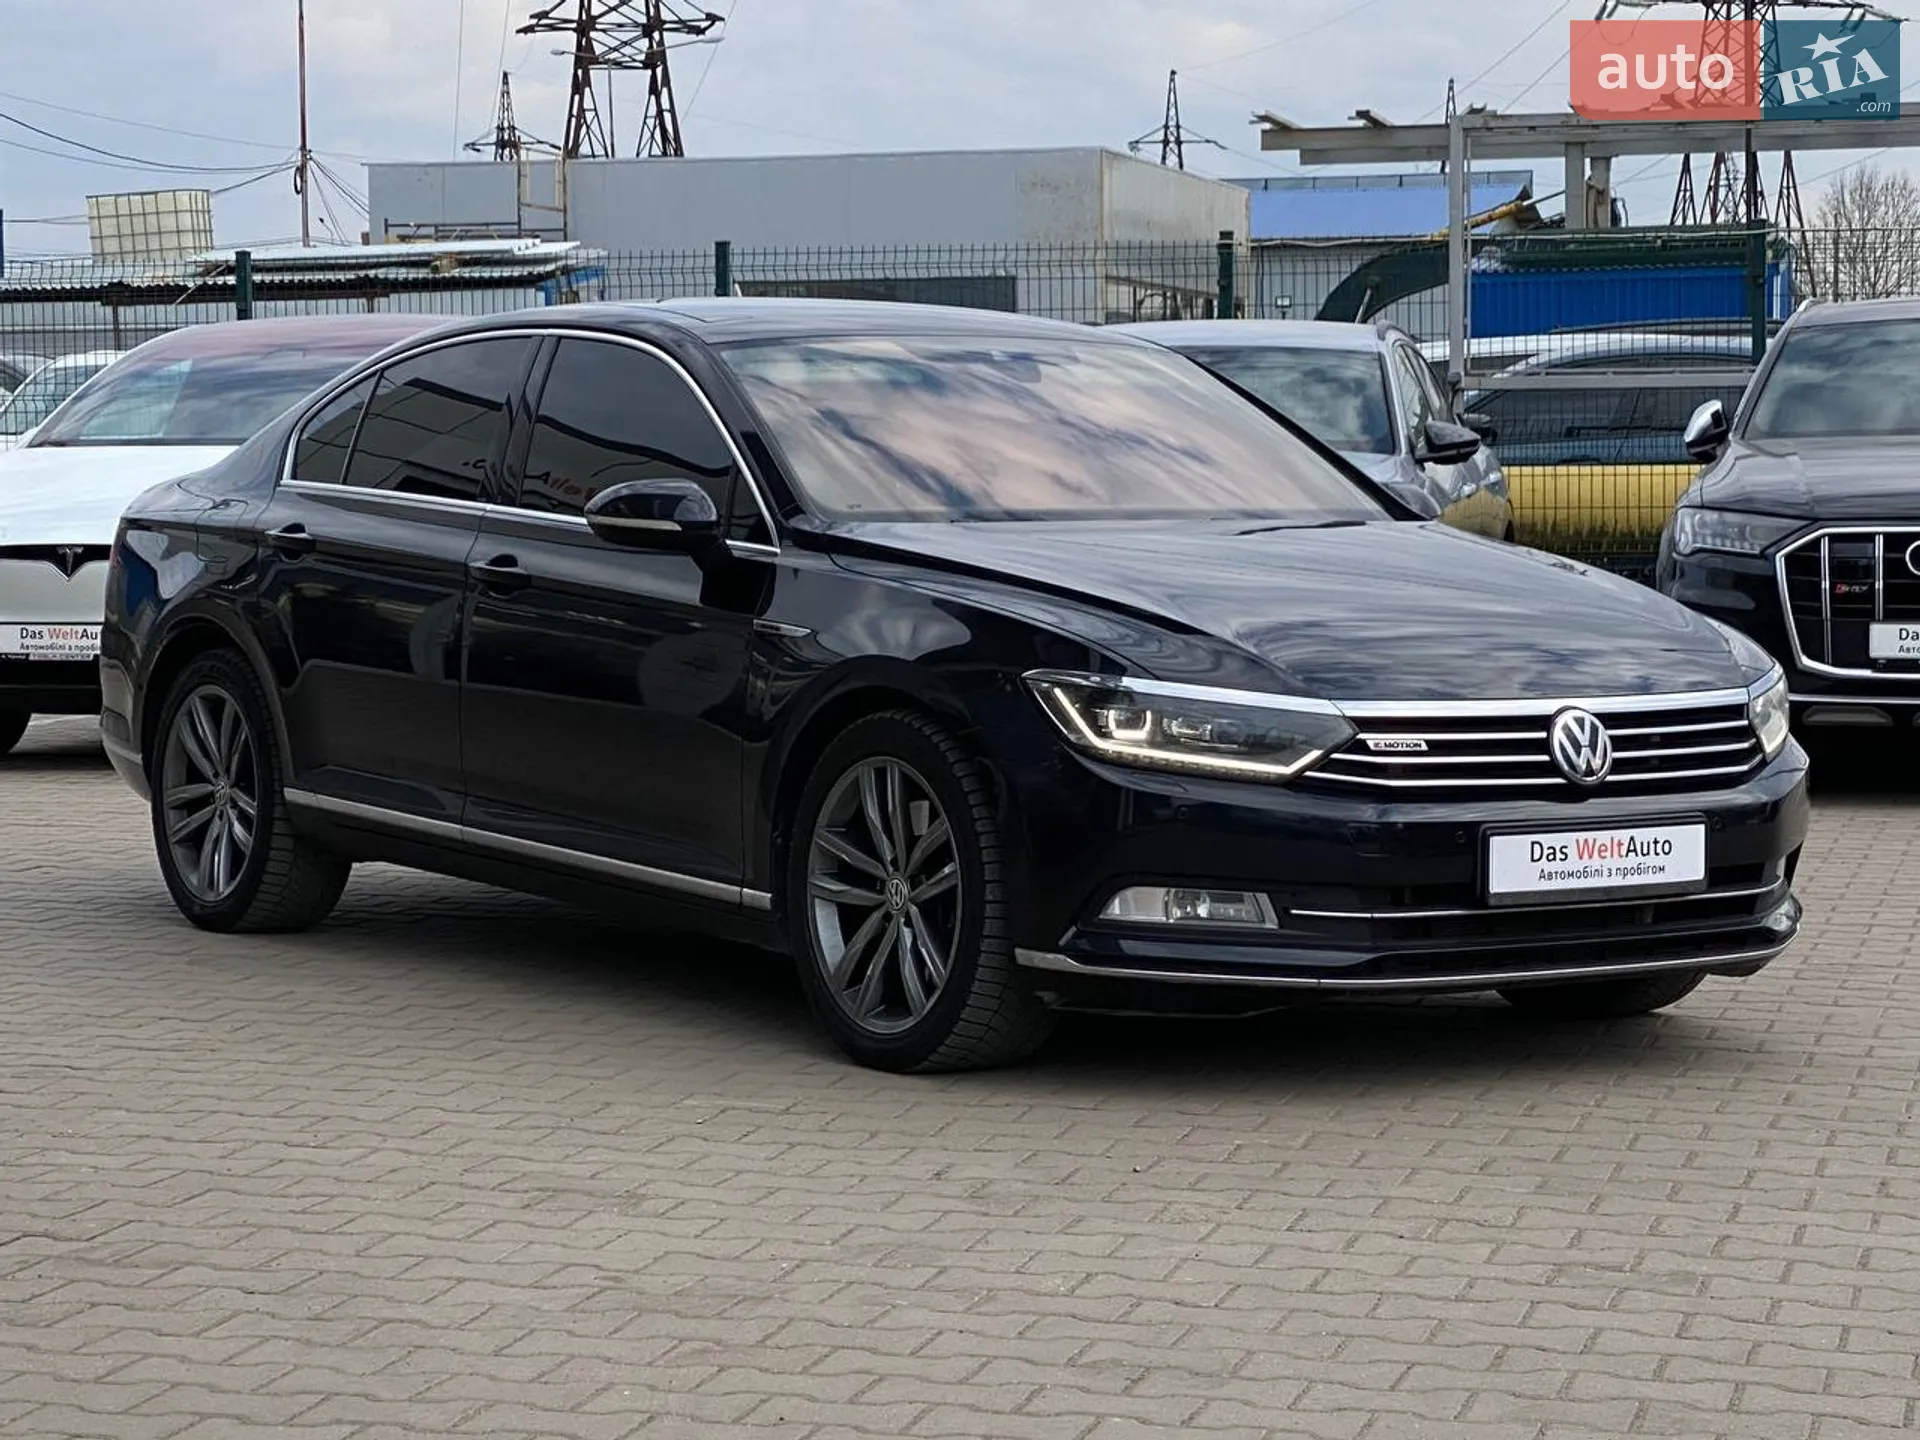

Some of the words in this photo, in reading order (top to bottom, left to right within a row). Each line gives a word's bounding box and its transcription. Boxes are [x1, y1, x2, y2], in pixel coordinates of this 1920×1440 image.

[20, 627, 44, 640] Das
[47, 627, 99, 640] WeltAu
[1898, 627, 1920, 641] Da
[1530, 840, 1569, 863] Das
[1575, 835, 1673, 861] WeltAuto
[1538, 864, 1604, 881] Автомобілі
[1606, 867, 1613, 878] з
[1615, 862, 1666, 880] пробігом
